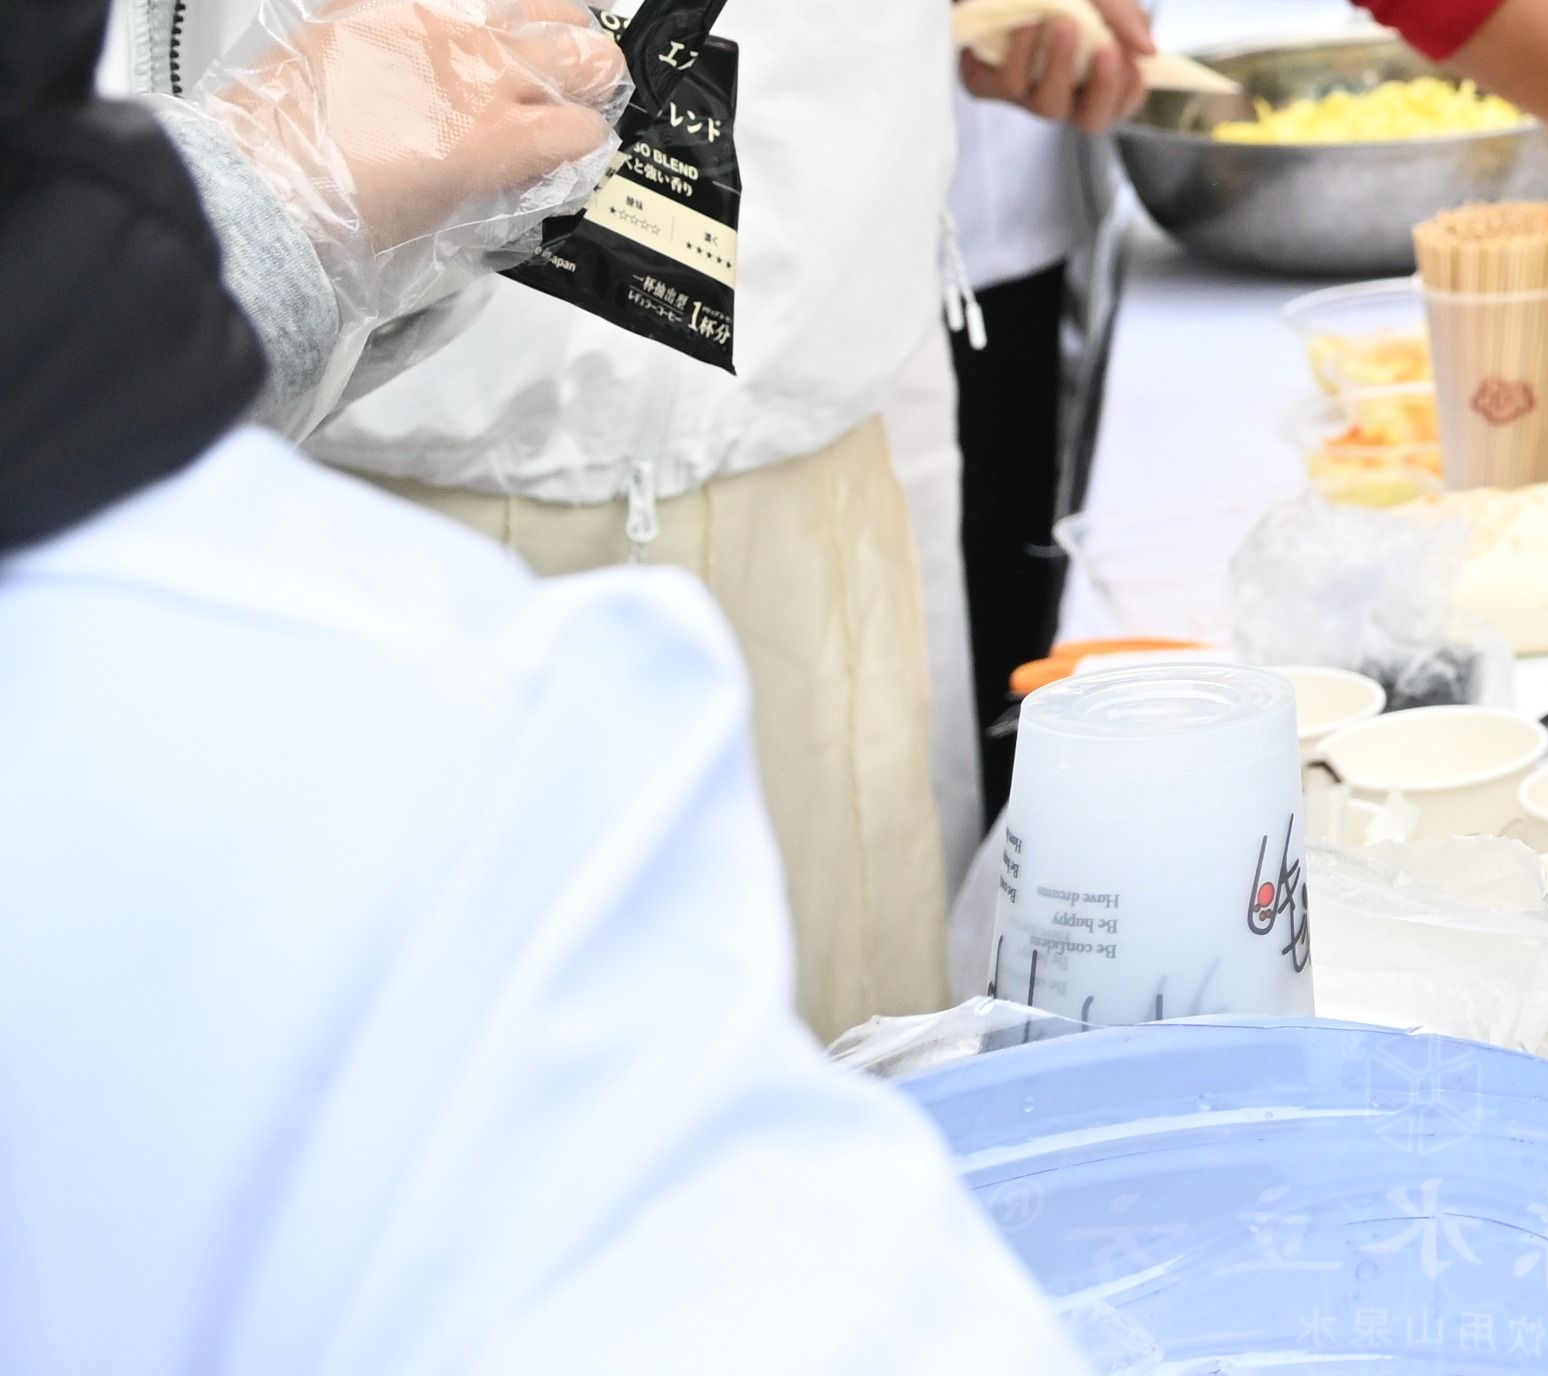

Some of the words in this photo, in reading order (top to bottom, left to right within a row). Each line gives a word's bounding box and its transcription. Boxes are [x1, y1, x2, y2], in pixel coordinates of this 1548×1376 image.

[670, 102, 722, 143] レンド
[653, 148, 699, 180] BLEND
[1081, 893, 1120, 909] Have
[1051, 910, 1094, 933] happy
[1098, 919, 1119, 934] Be
[1096, 944, 1117, 959] Be
